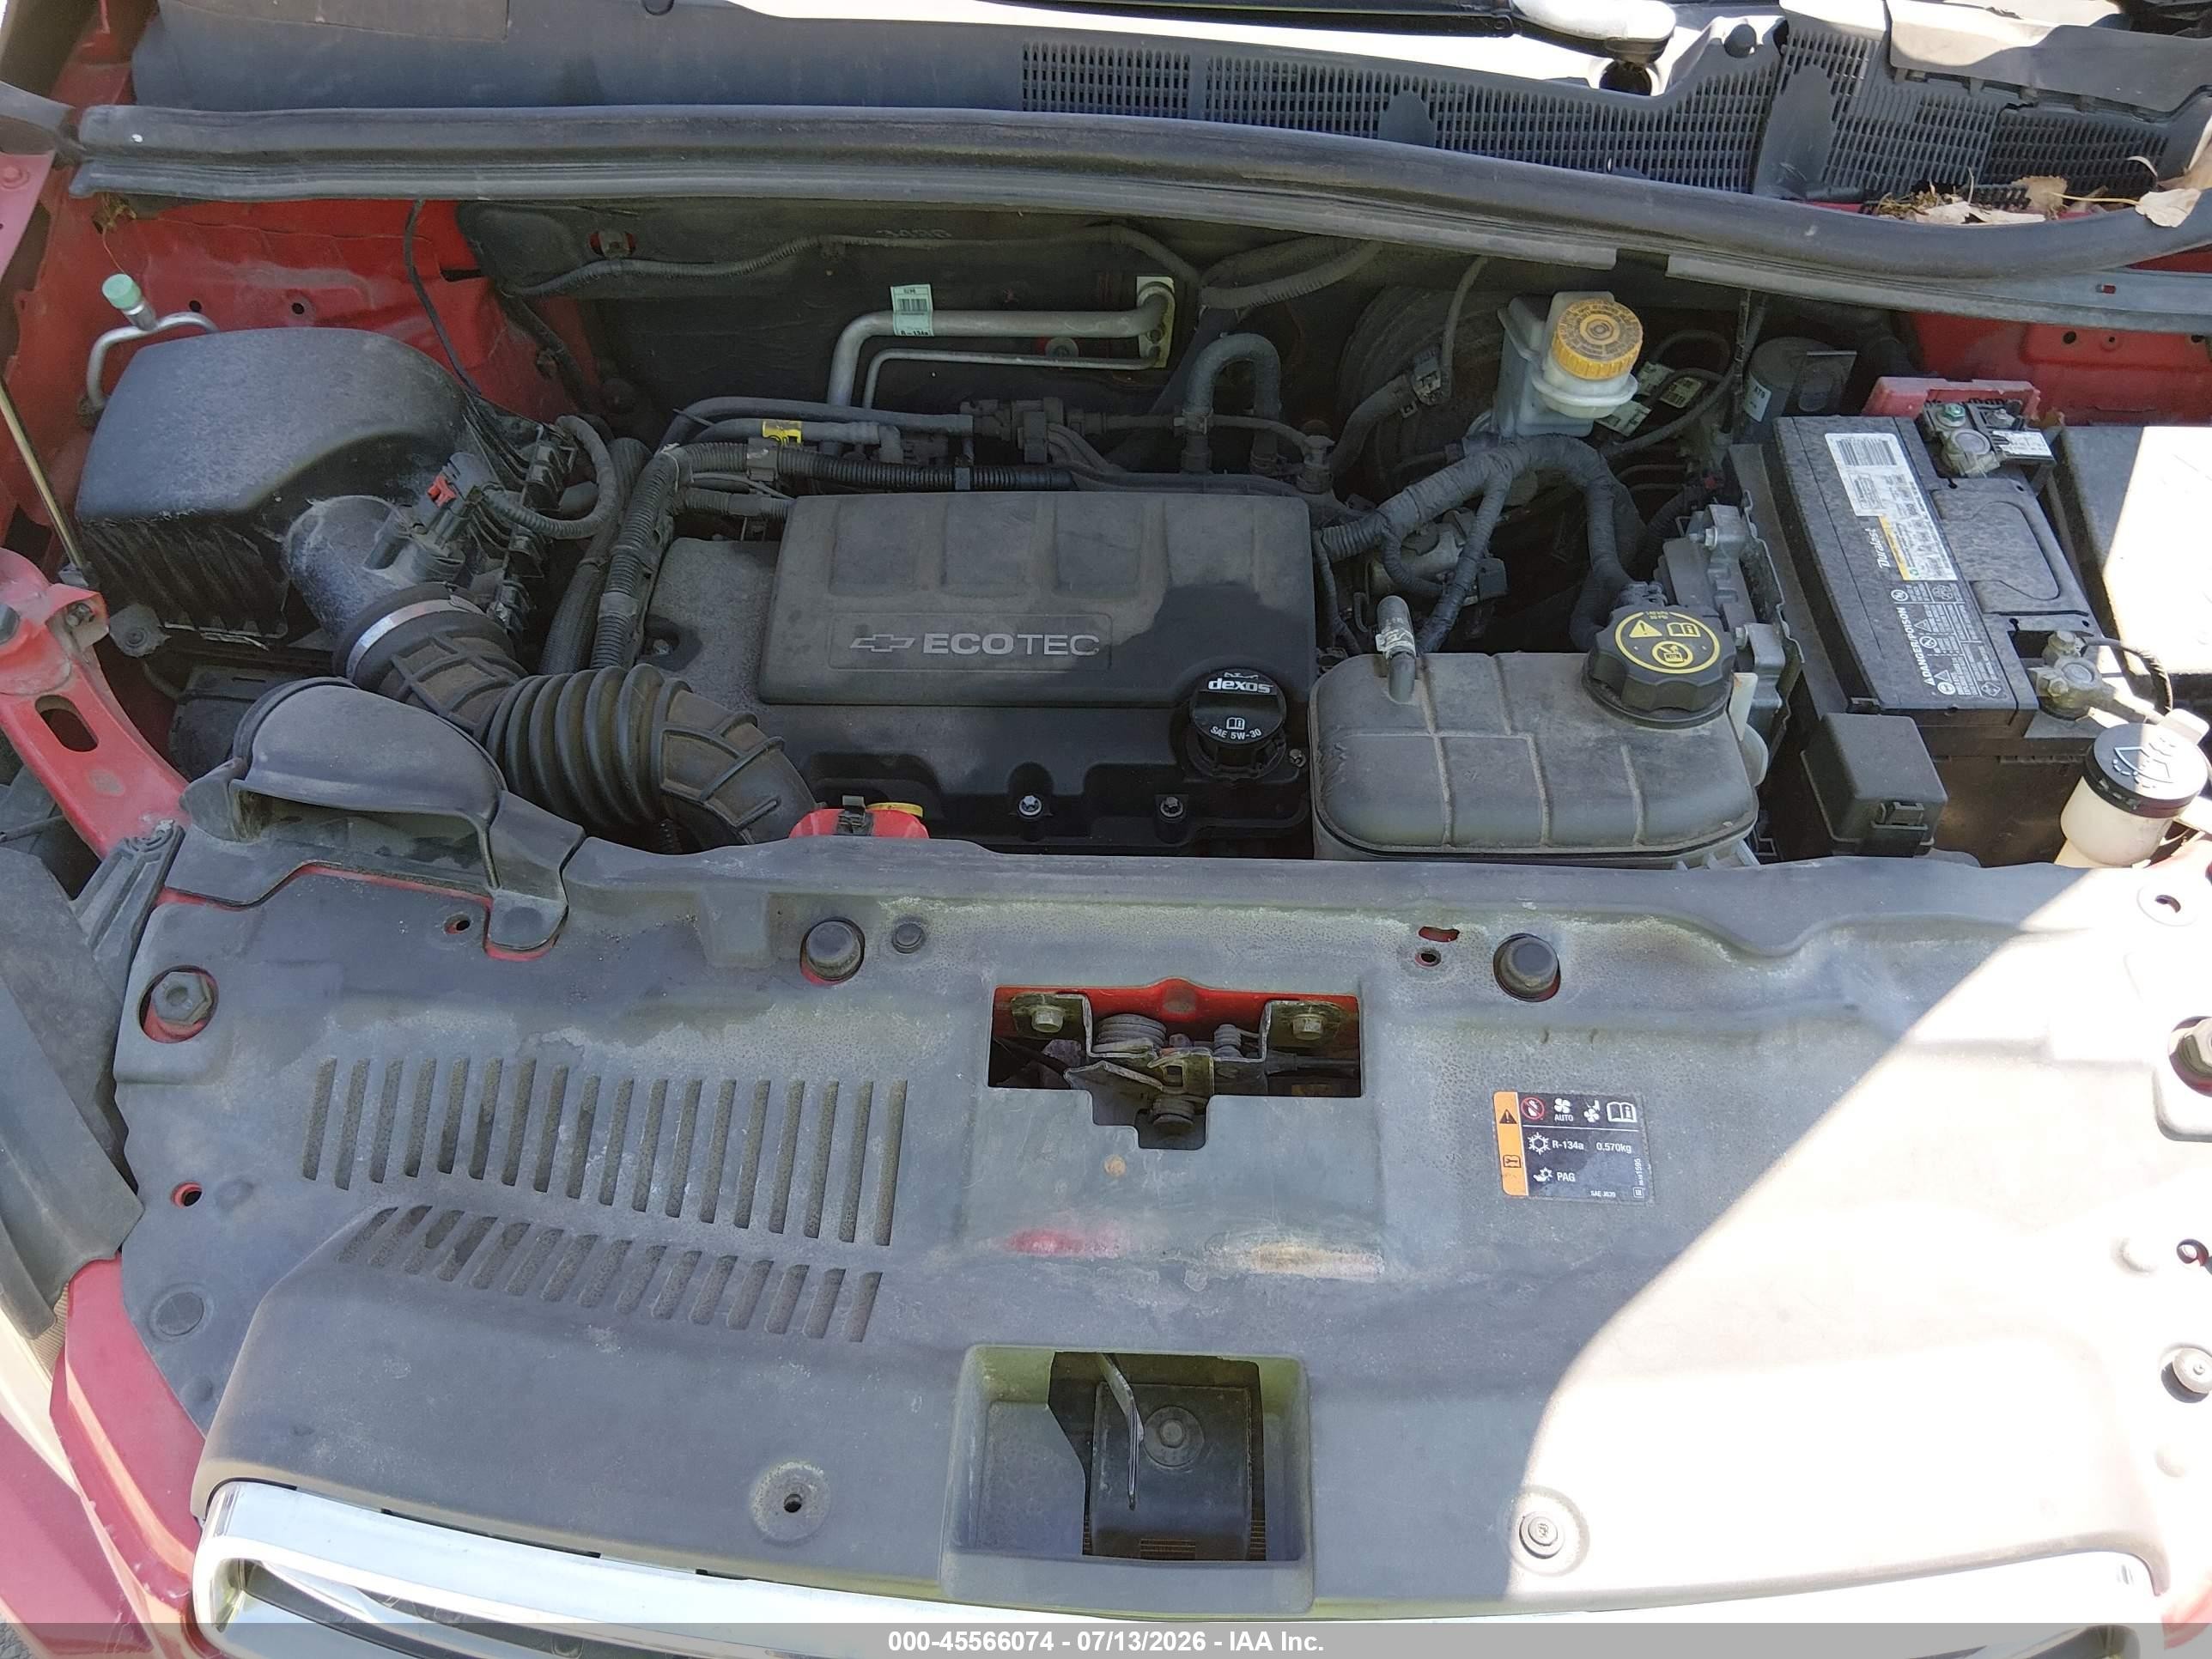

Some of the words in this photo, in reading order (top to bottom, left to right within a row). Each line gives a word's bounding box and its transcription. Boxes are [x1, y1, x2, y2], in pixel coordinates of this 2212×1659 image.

[1864, 527, 1890, 569] Duralast
[922, 632, 1100, 656] ECOTEC
[1207, 678, 1273, 694] dexos
[1210, 726, 1228, 738] SAE
[1230, 728, 1262, 740] 5W-30
[1553, 1114, 1574, 1122] AUTO
[1552, 1139, 1585, 1151] R-134a
[1595, 1141, 1632, 1154] 0.570kg
[1556, 1171, 1577, 1182] PAG
